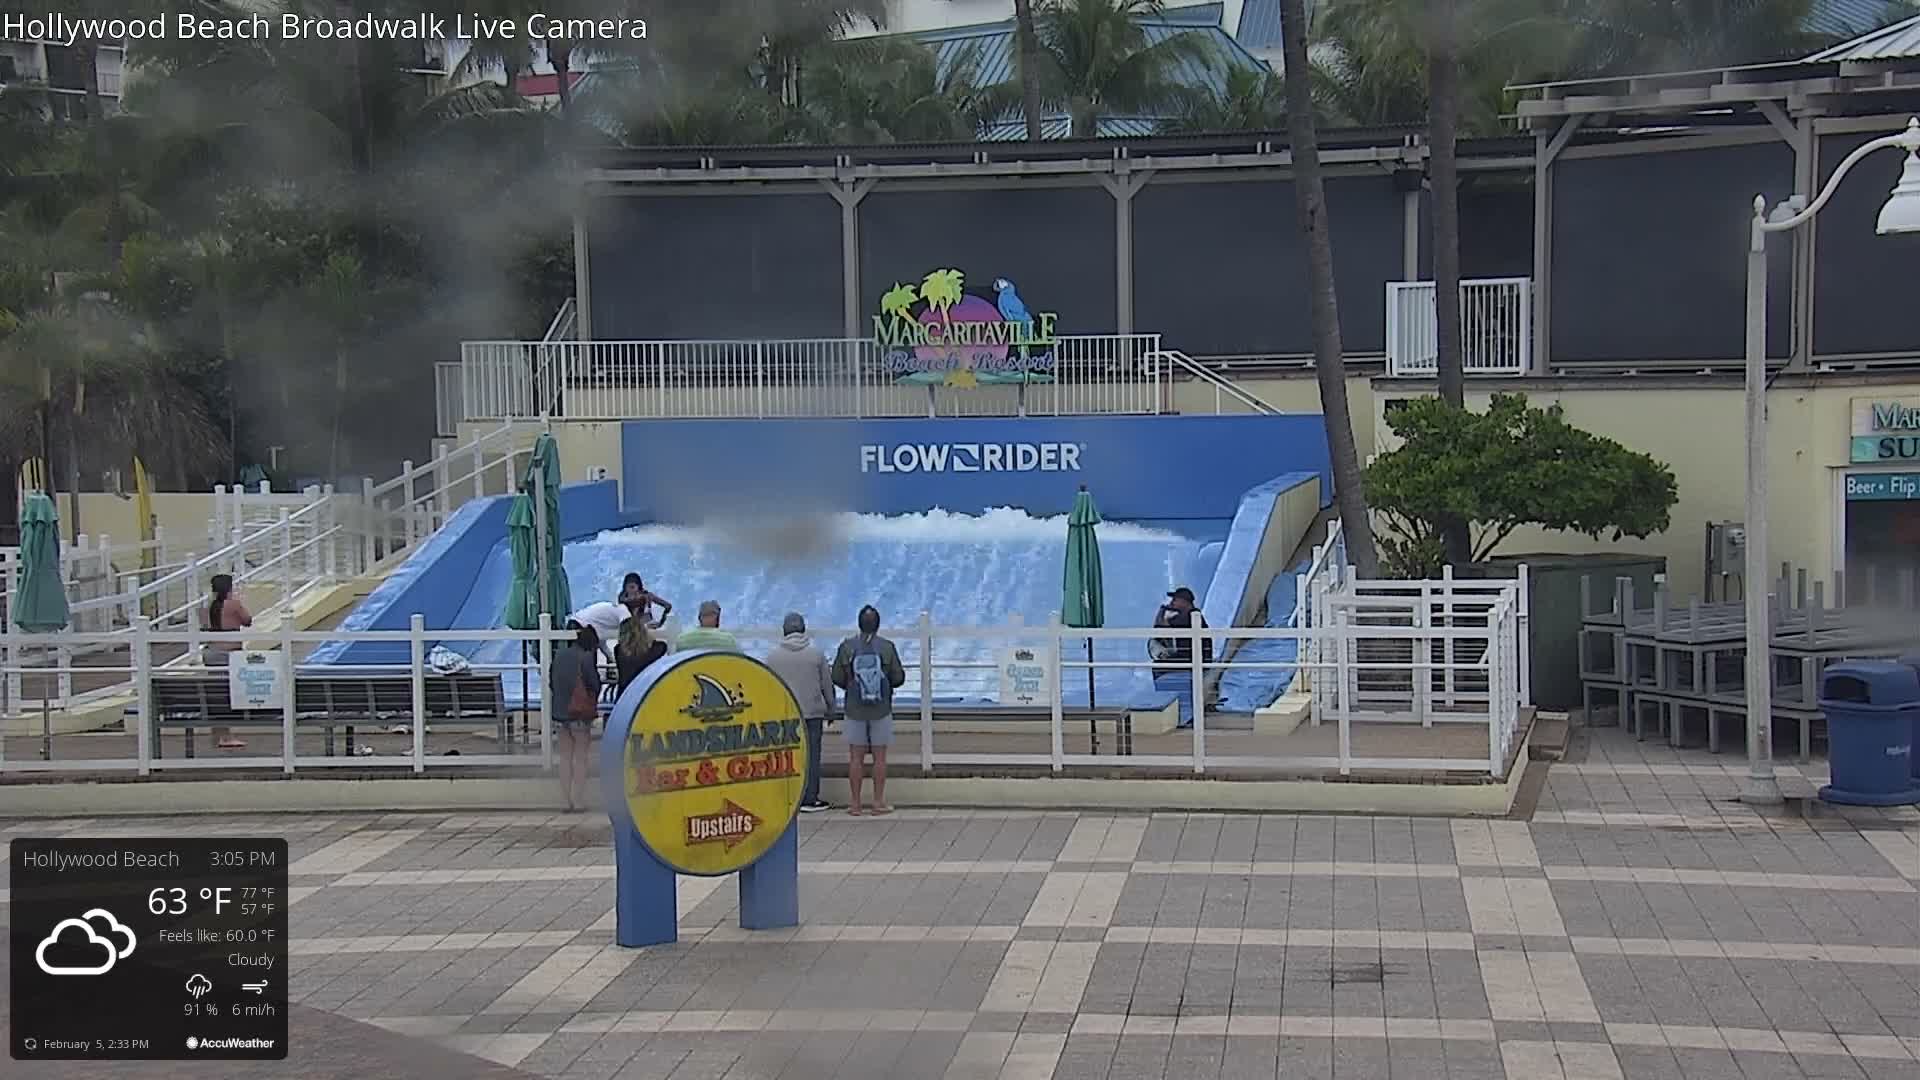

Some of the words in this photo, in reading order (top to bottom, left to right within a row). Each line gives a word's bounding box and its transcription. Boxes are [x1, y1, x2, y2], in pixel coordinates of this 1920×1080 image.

[872, 312, 1058, 347] MARGARITAVILLE
[884, 350, 960, 371] Beach
[971, 350, 1054, 371] Resort
[860, 444, 950, 473] FLOW
[983, 443, 1081, 472] RIDER
[1878, 437, 1920, 458] SU
[1846, 477, 1876, 494] Beer
[1890, 476, 1916, 499] Flip
[630, 719, 803, 760] LANDSHARK
[695, 759, 720, 785] &
[727, 749, 796, 779] Grill
[690, 813, 754, 839] Upstairs
